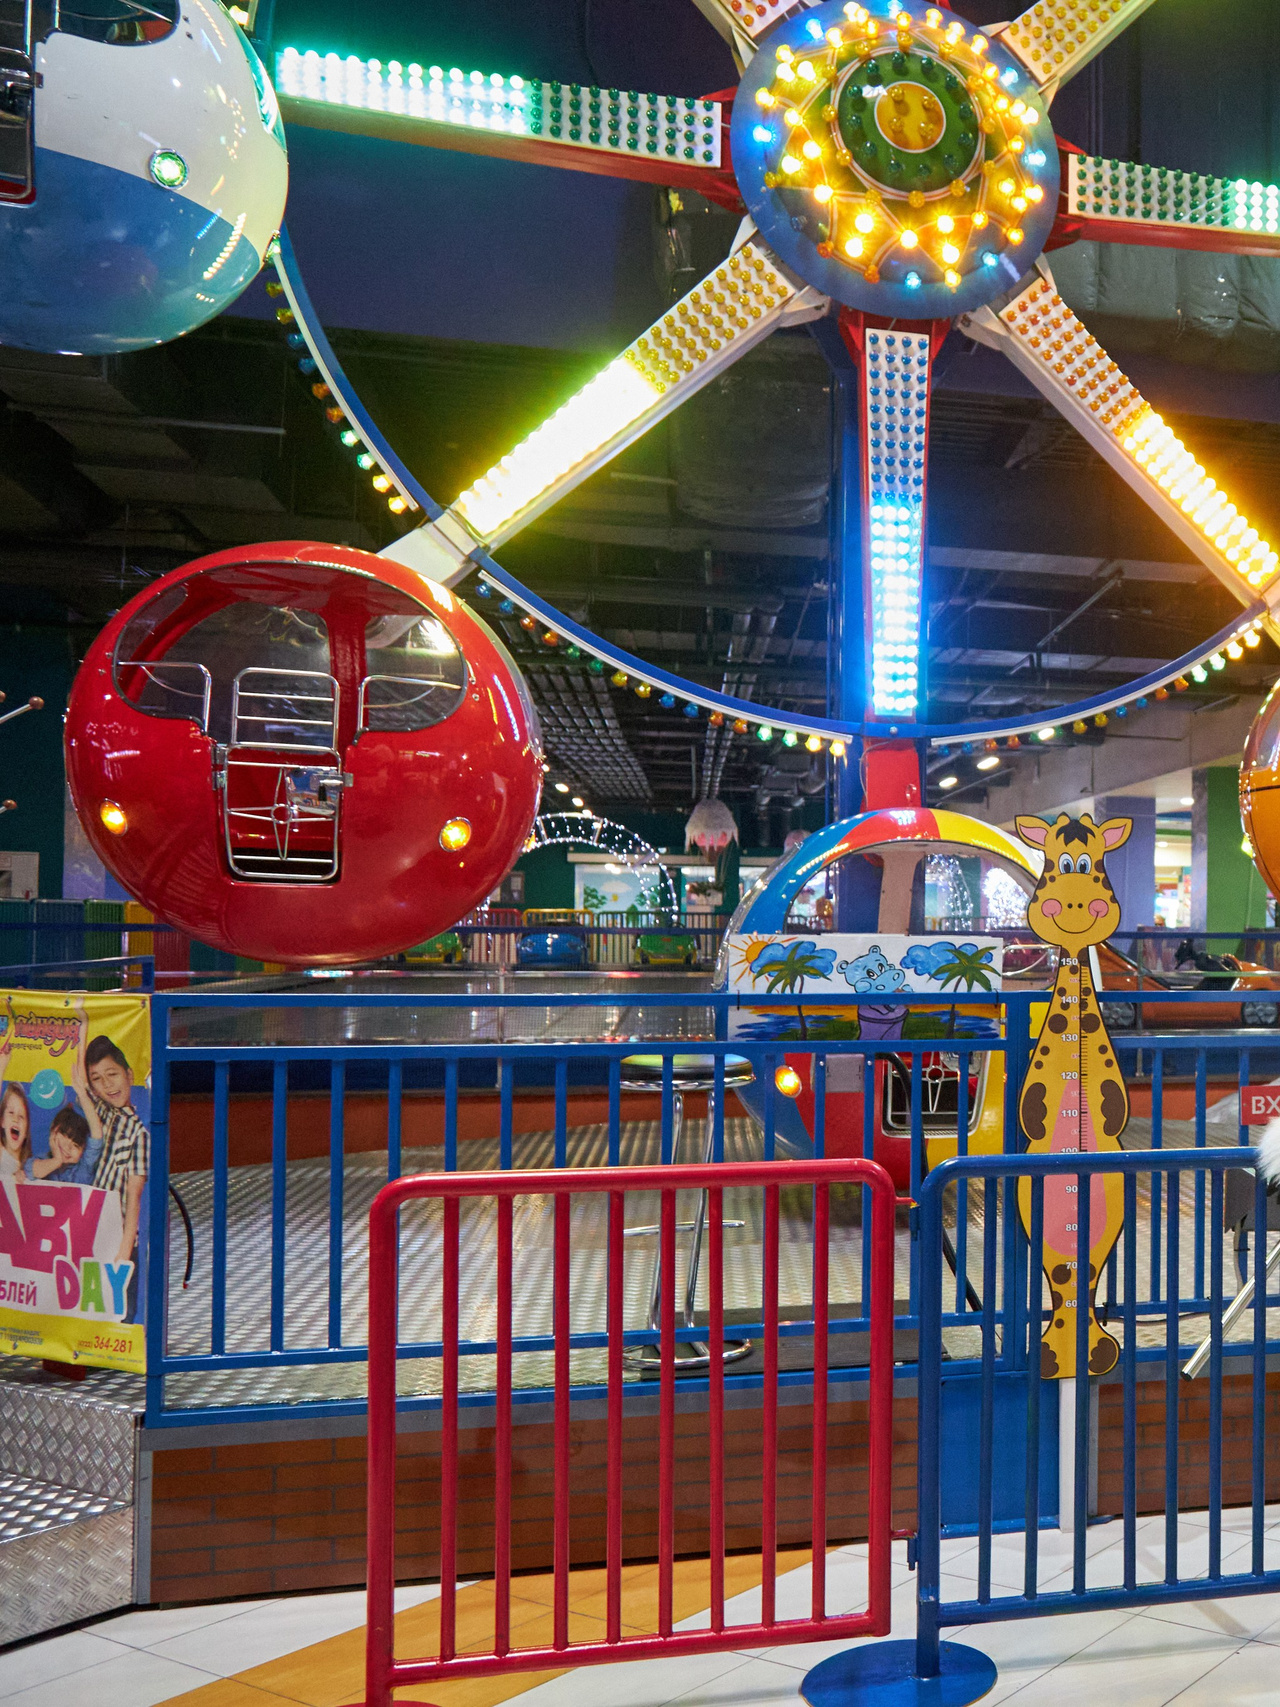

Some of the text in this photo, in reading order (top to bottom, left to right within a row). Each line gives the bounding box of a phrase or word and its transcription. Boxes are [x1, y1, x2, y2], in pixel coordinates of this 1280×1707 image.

[1061, 958, 1078, 966] 150
[1061, 995, 1078, 1004] 140
[1061, 1033, 1078, 1042] 130
[1061, 1071, 1078, 1080] 120
[1061, 1109, 1078, 1117] 110
[1065, 1185, 1078, 1194] 90
[1065, 1223, 1078, 1232] 80
[1065, 1261, 1078, 1270] 70
[55, 1259, 131, 1315] DAY
[1065, 1299, 1078, 1308] 60
[94, 1335, 133, 1353] 364-281
